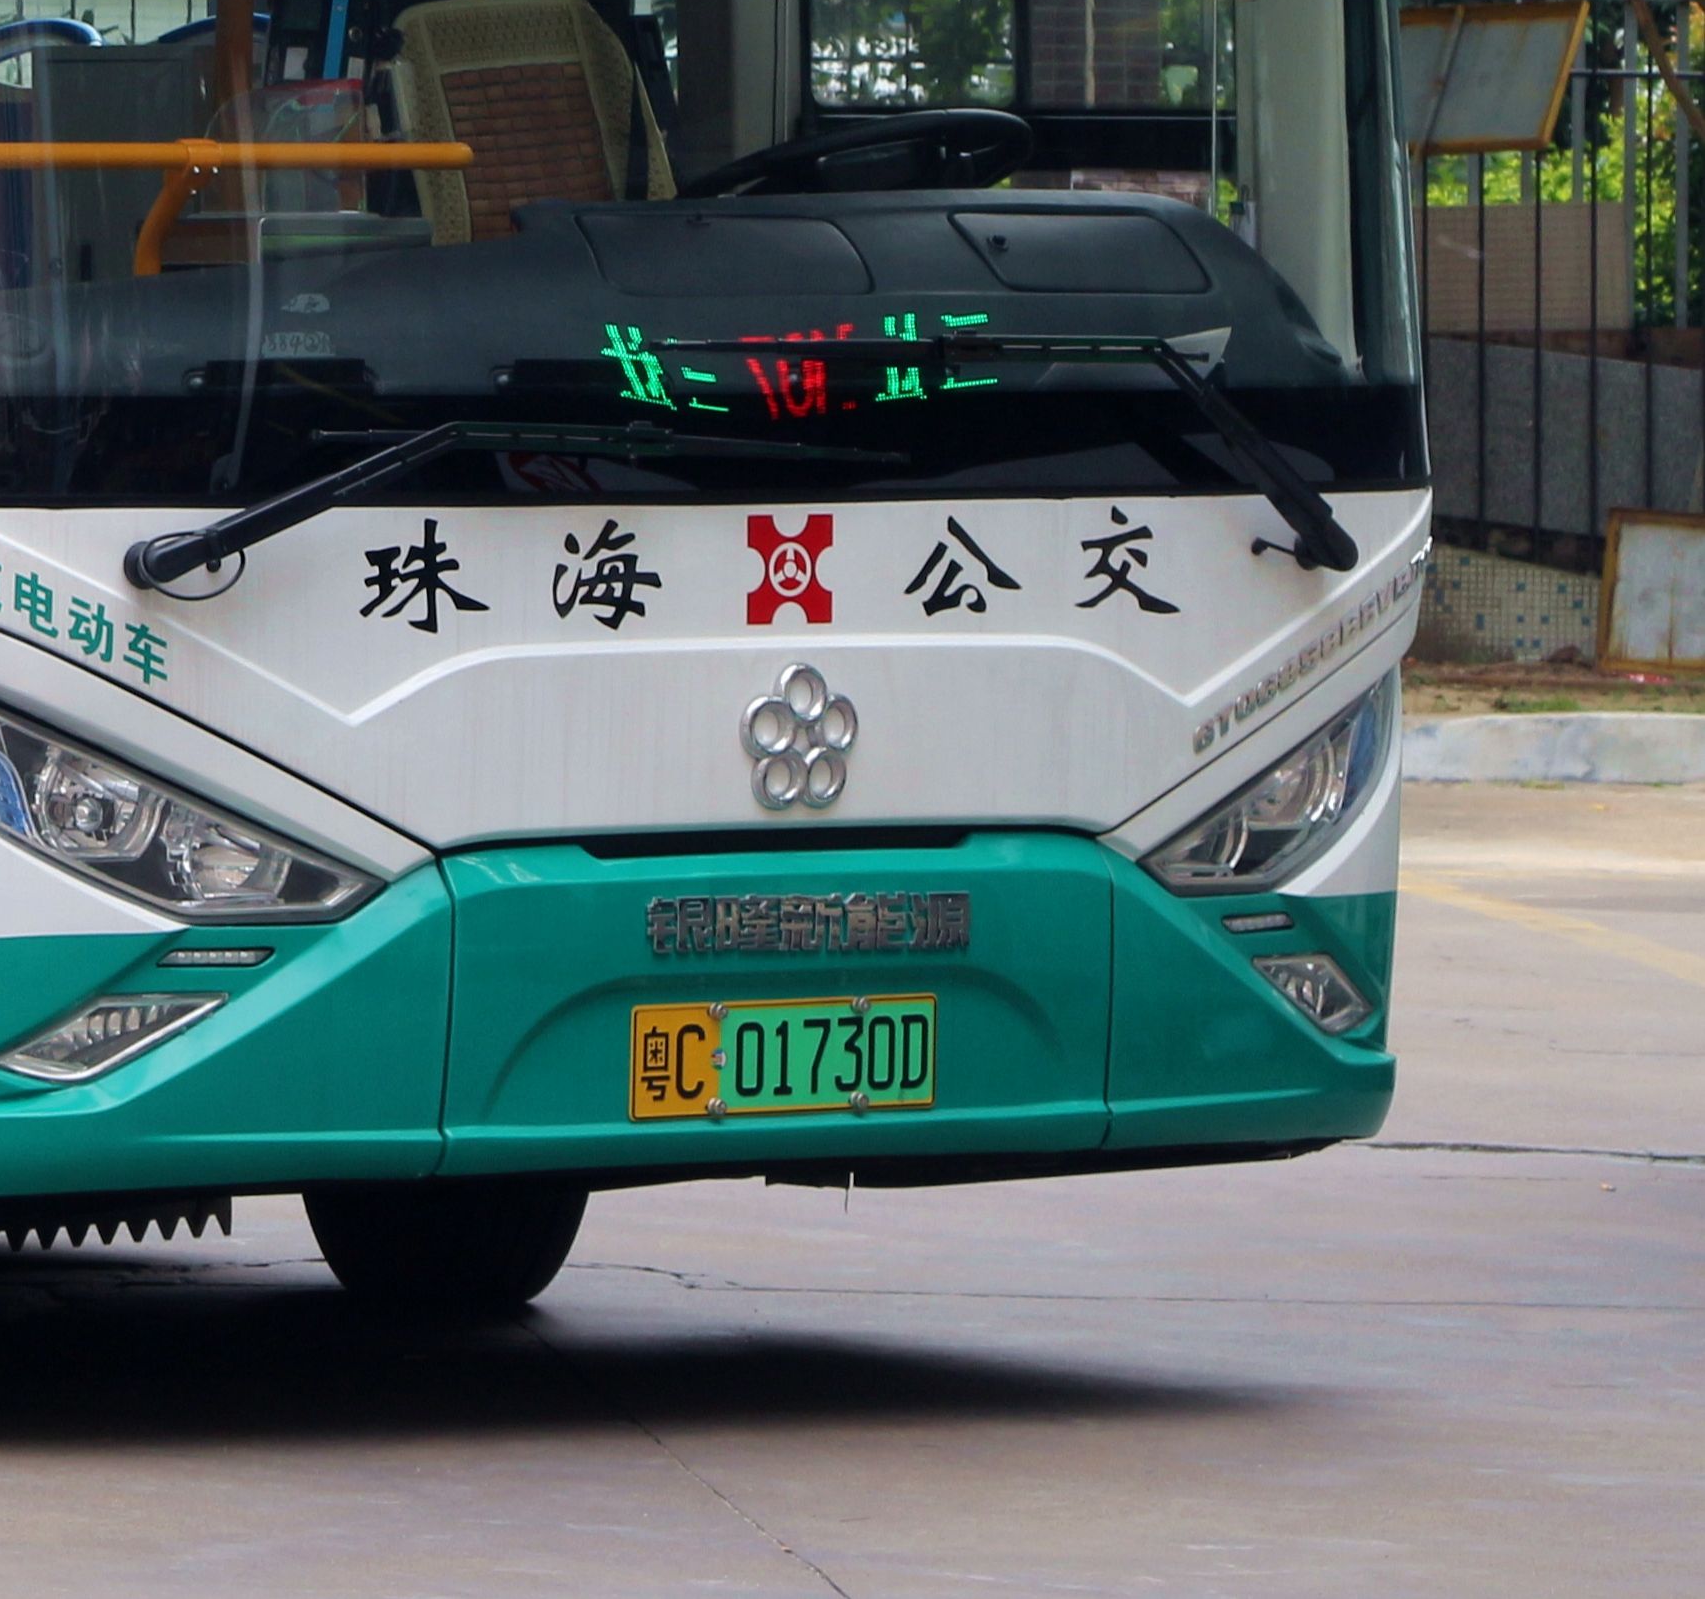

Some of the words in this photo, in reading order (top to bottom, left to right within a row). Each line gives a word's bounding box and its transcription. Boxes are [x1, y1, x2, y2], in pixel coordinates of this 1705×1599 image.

[358, 517, 662, 634] 珠海
[904, 505, 1182, 616] 公交
[646, 890, 971, 955] 银隆新能源
[640, 1022, 706, 1102] 粤C
[734, 1013, 930, 1098] 01730D
